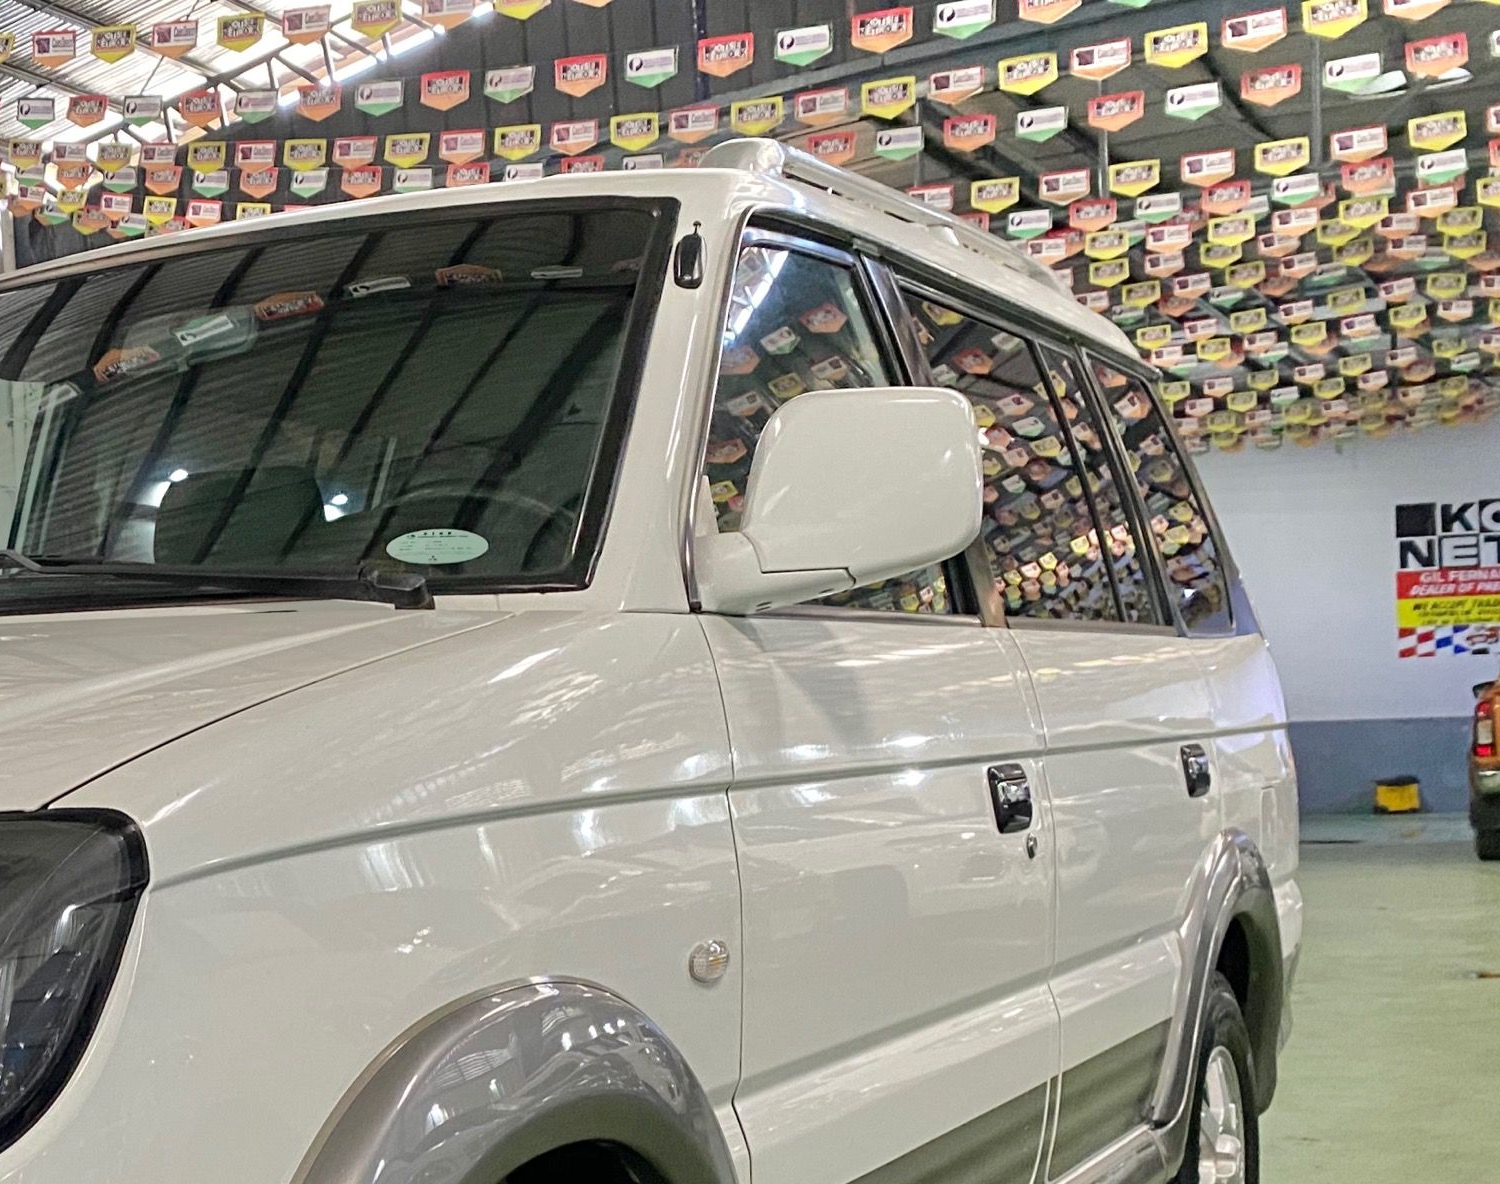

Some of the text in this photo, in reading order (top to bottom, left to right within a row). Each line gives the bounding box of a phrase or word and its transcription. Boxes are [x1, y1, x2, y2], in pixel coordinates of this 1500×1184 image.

[1419, 572, 1446, 583] GIL
[1410, 584, 1456, 596] DEALER
[1458, 582, 1475, 593] OF
